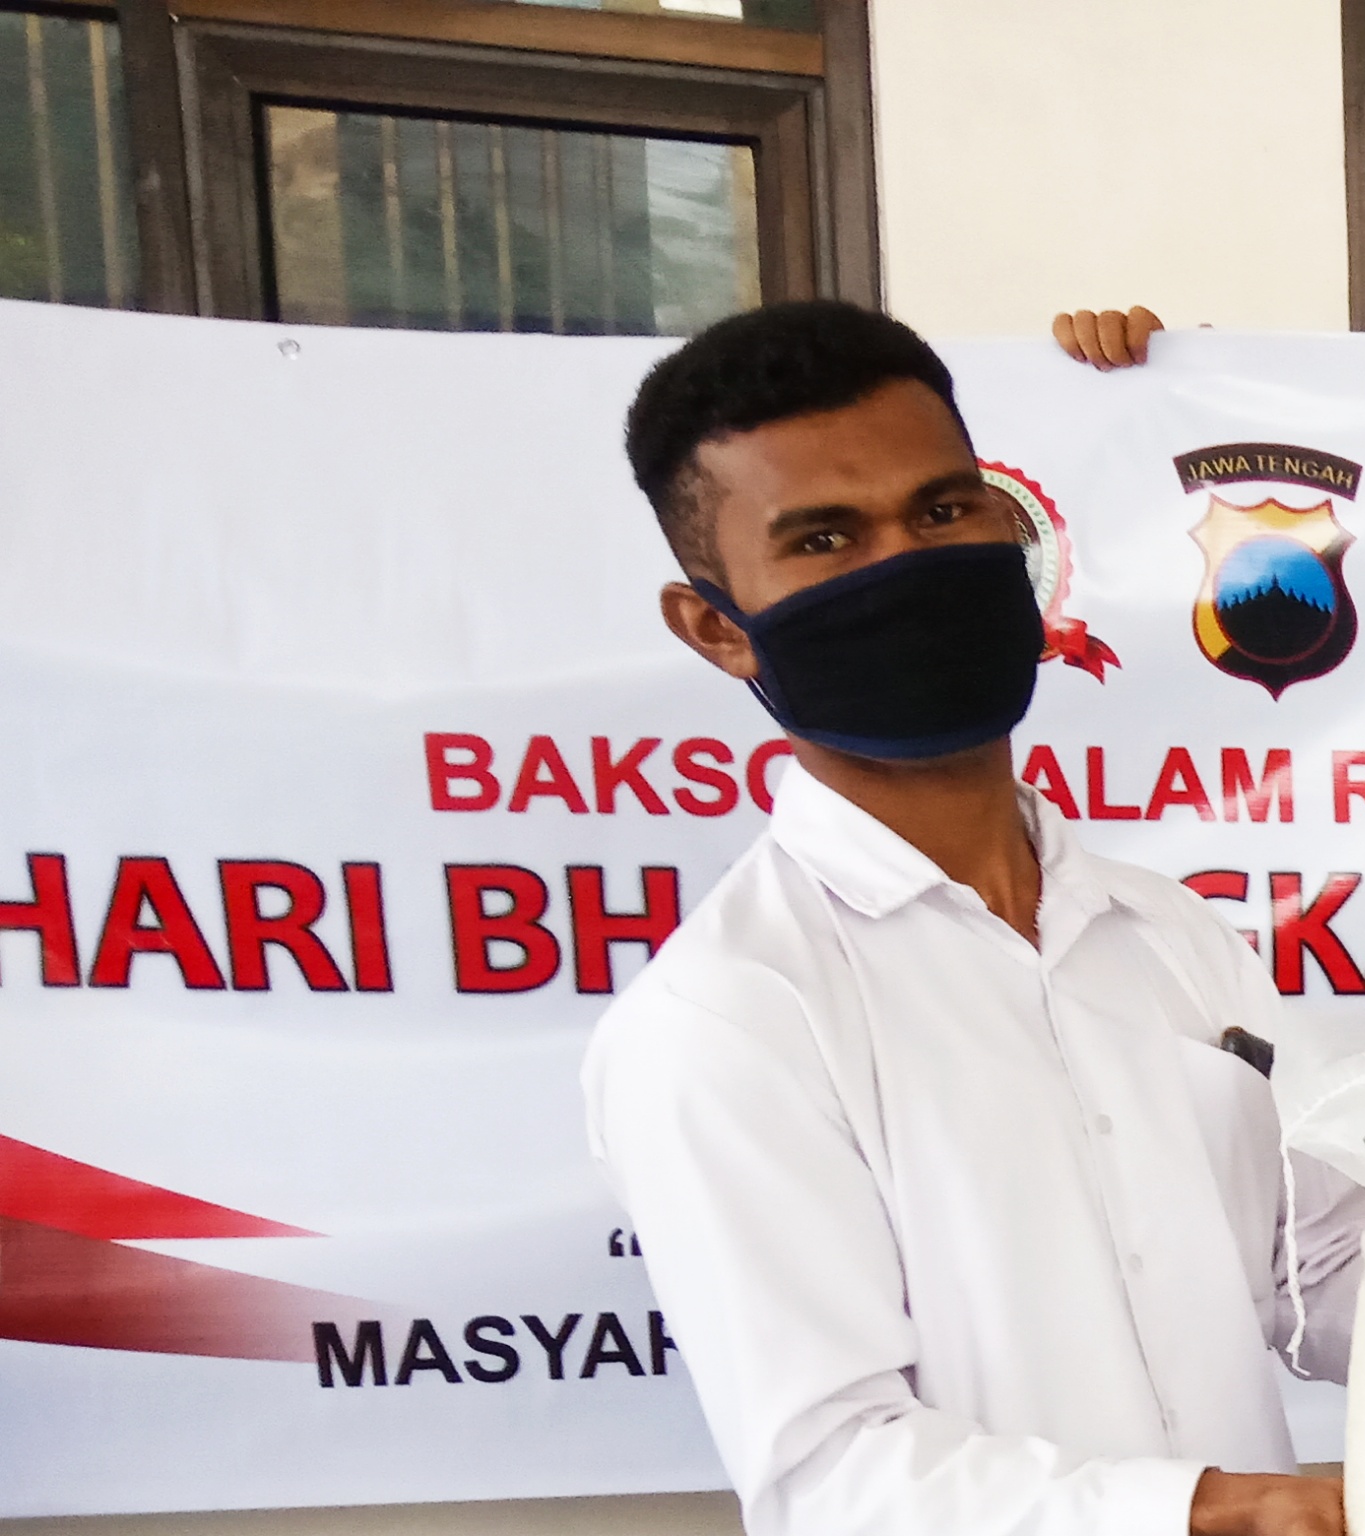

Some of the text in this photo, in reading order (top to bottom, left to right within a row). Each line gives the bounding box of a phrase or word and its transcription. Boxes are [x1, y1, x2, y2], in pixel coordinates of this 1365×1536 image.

[1187, 455, 1354, 489] JAWA TENGAH
[424, 731, 794, 817] BAKSO
[1020, 744, 1295, 822] ALAM
[0, 852, 394, 992] HARI
